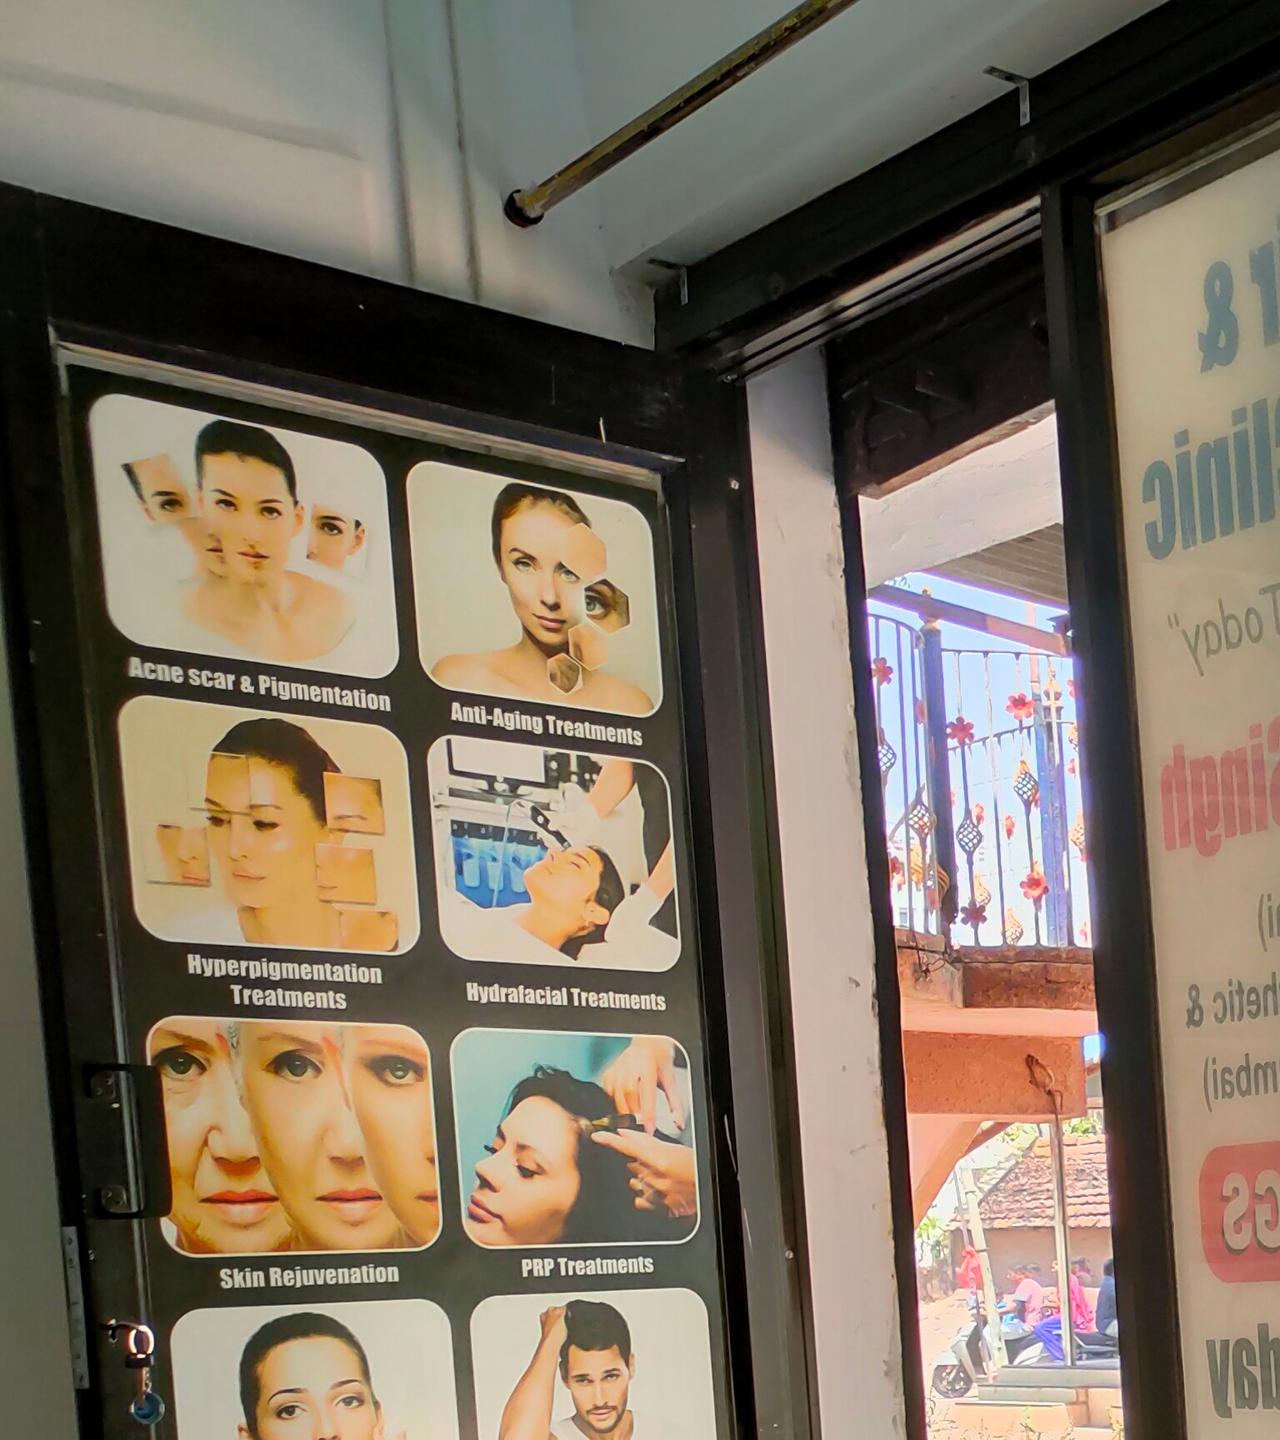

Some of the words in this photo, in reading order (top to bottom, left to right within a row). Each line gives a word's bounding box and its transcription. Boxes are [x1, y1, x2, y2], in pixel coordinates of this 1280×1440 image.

[128, 656, 184, 688] Acne
[188, 664, 236, 693] scar
[240, 673, 255, 694] &
[258, 674, 391, 712] Pigmentation
[450, 701, 543, 735] Anti-Aging
[545, 714, 643, 746] Treatments
[187, 952, 383, 986] Hyperpigmentation
[230, 984, 347, 1011] Treatments
[465, 981, 571, 1008] Hydrafacial
[572, 985, 667, 1012] Treatments
[218, 1265, 266, 1289] Skin
[269, 1262, 400, 1289] Rejuvenation
[521, 1257, 555, 1278] PRP
[556, 1255, 654, 1276] Treatments
